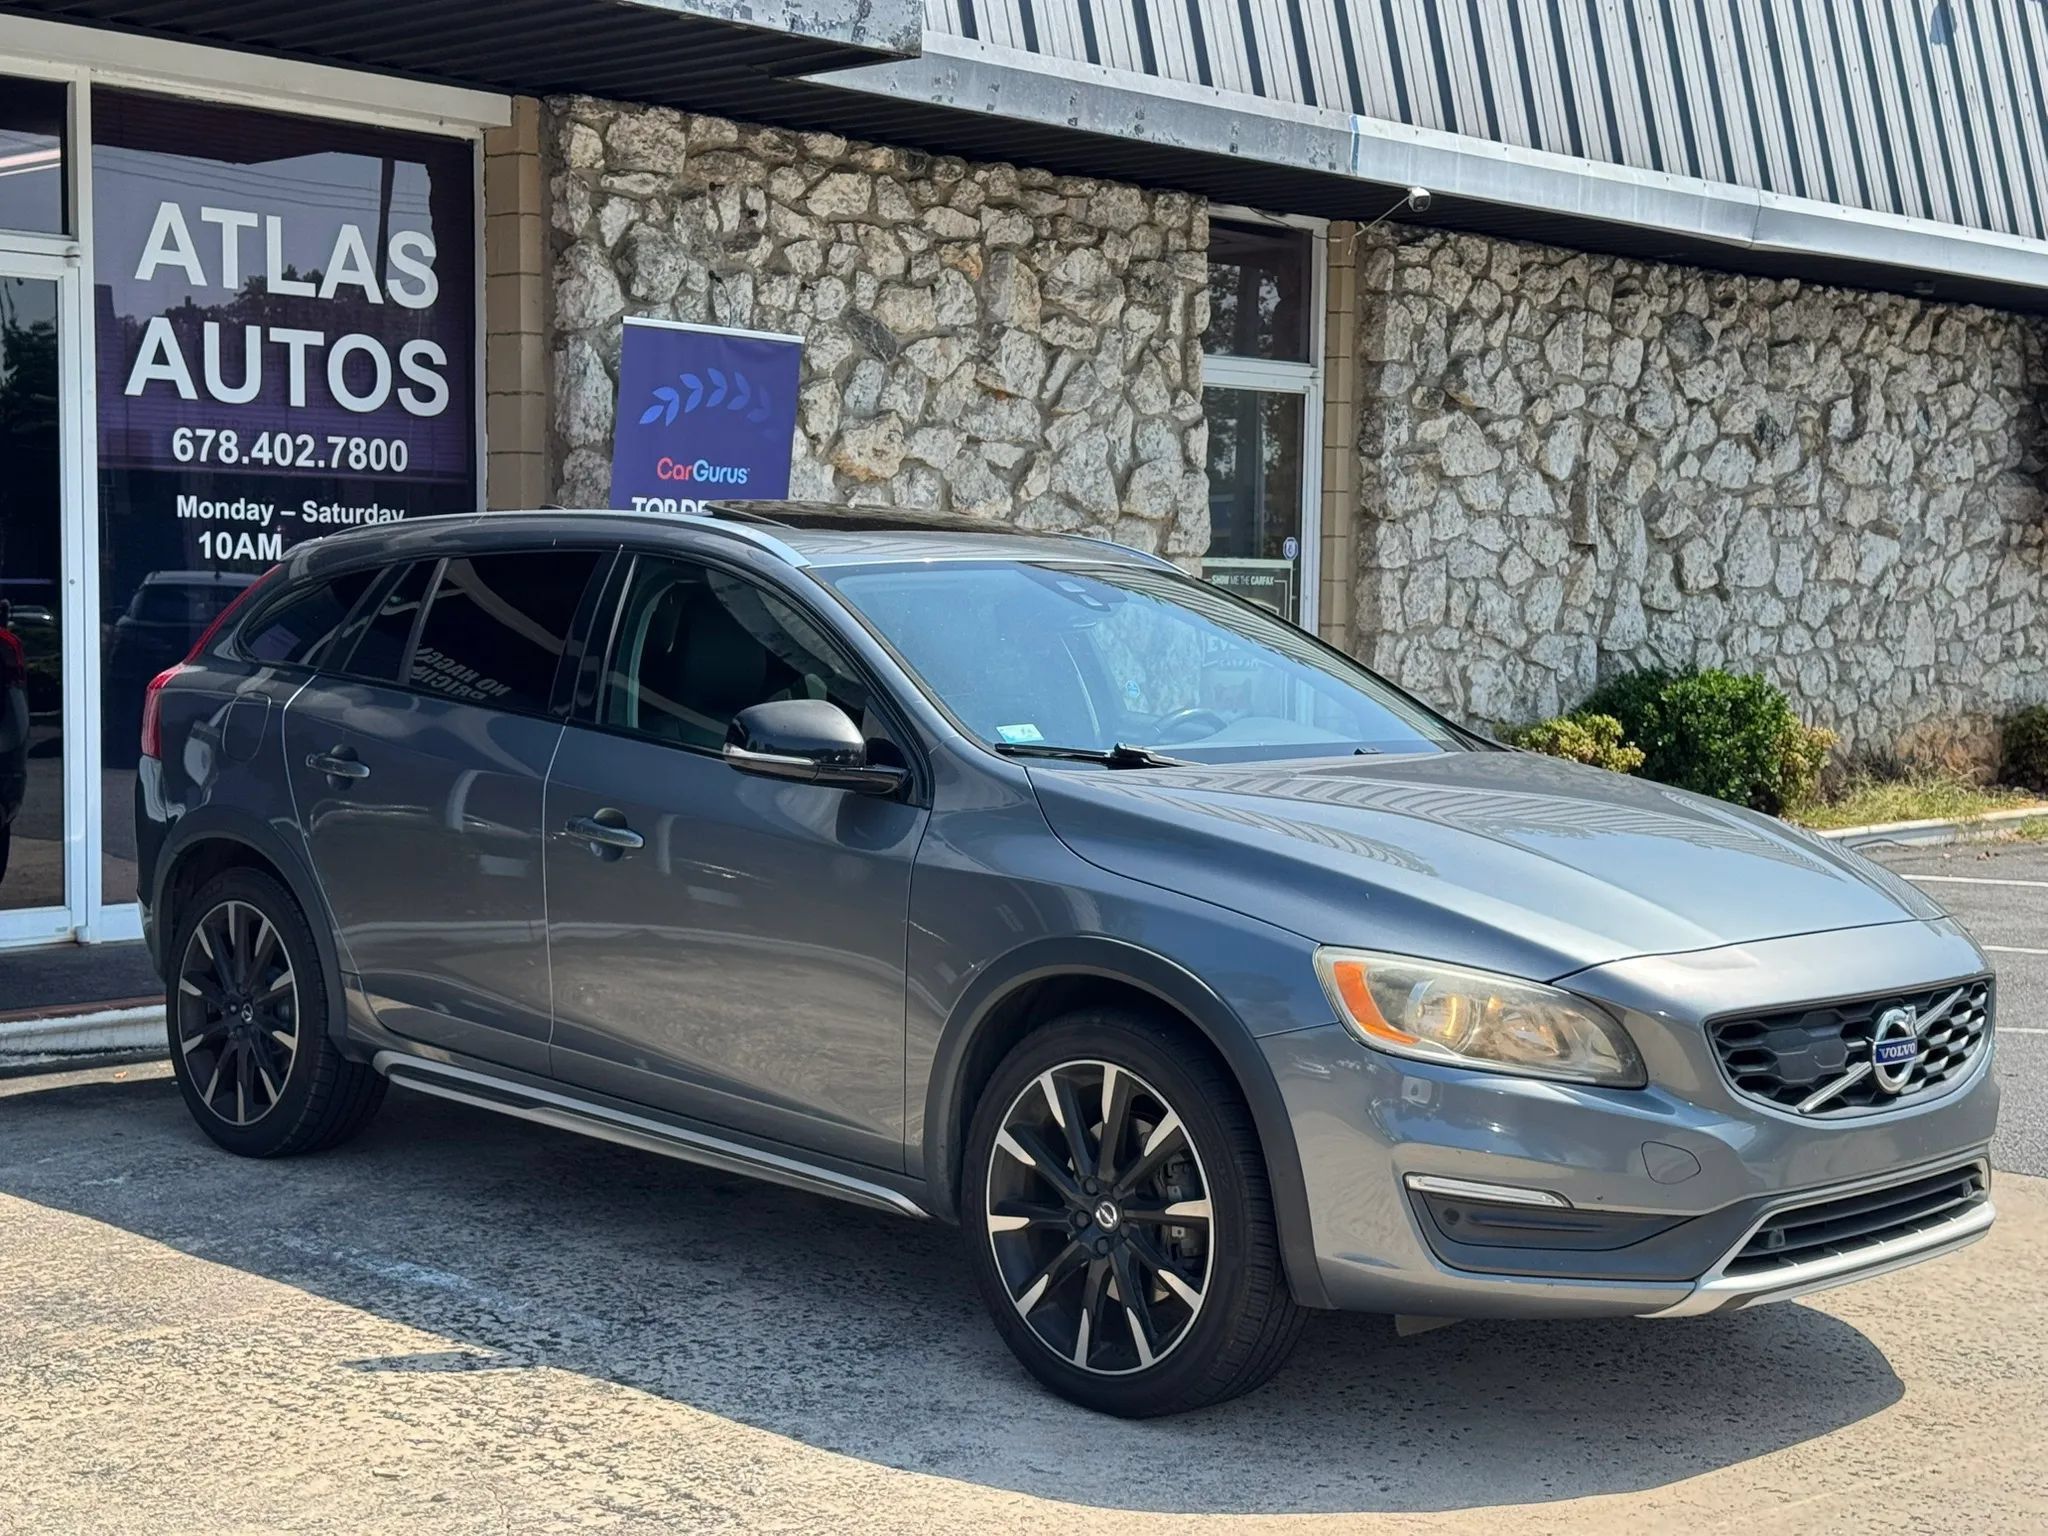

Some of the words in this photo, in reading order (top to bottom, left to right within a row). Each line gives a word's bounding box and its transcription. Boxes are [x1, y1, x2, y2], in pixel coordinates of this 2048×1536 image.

[135, 202, 438, 309] ATLAS
[125, 317, 449, 417] AUTOS
[172, 428, 408, 472] 678.402.7800
[657, 457, 748, 484] CarGurus
[177, 496, 274, 526] Monday
[198, 532, 282, 561] 10AM
[1211, 575, 1229, 586] SHOW
[1250, 576, 1275, 586] CARFAX
[1879, 1043, 1915, 1058] VOLVO
